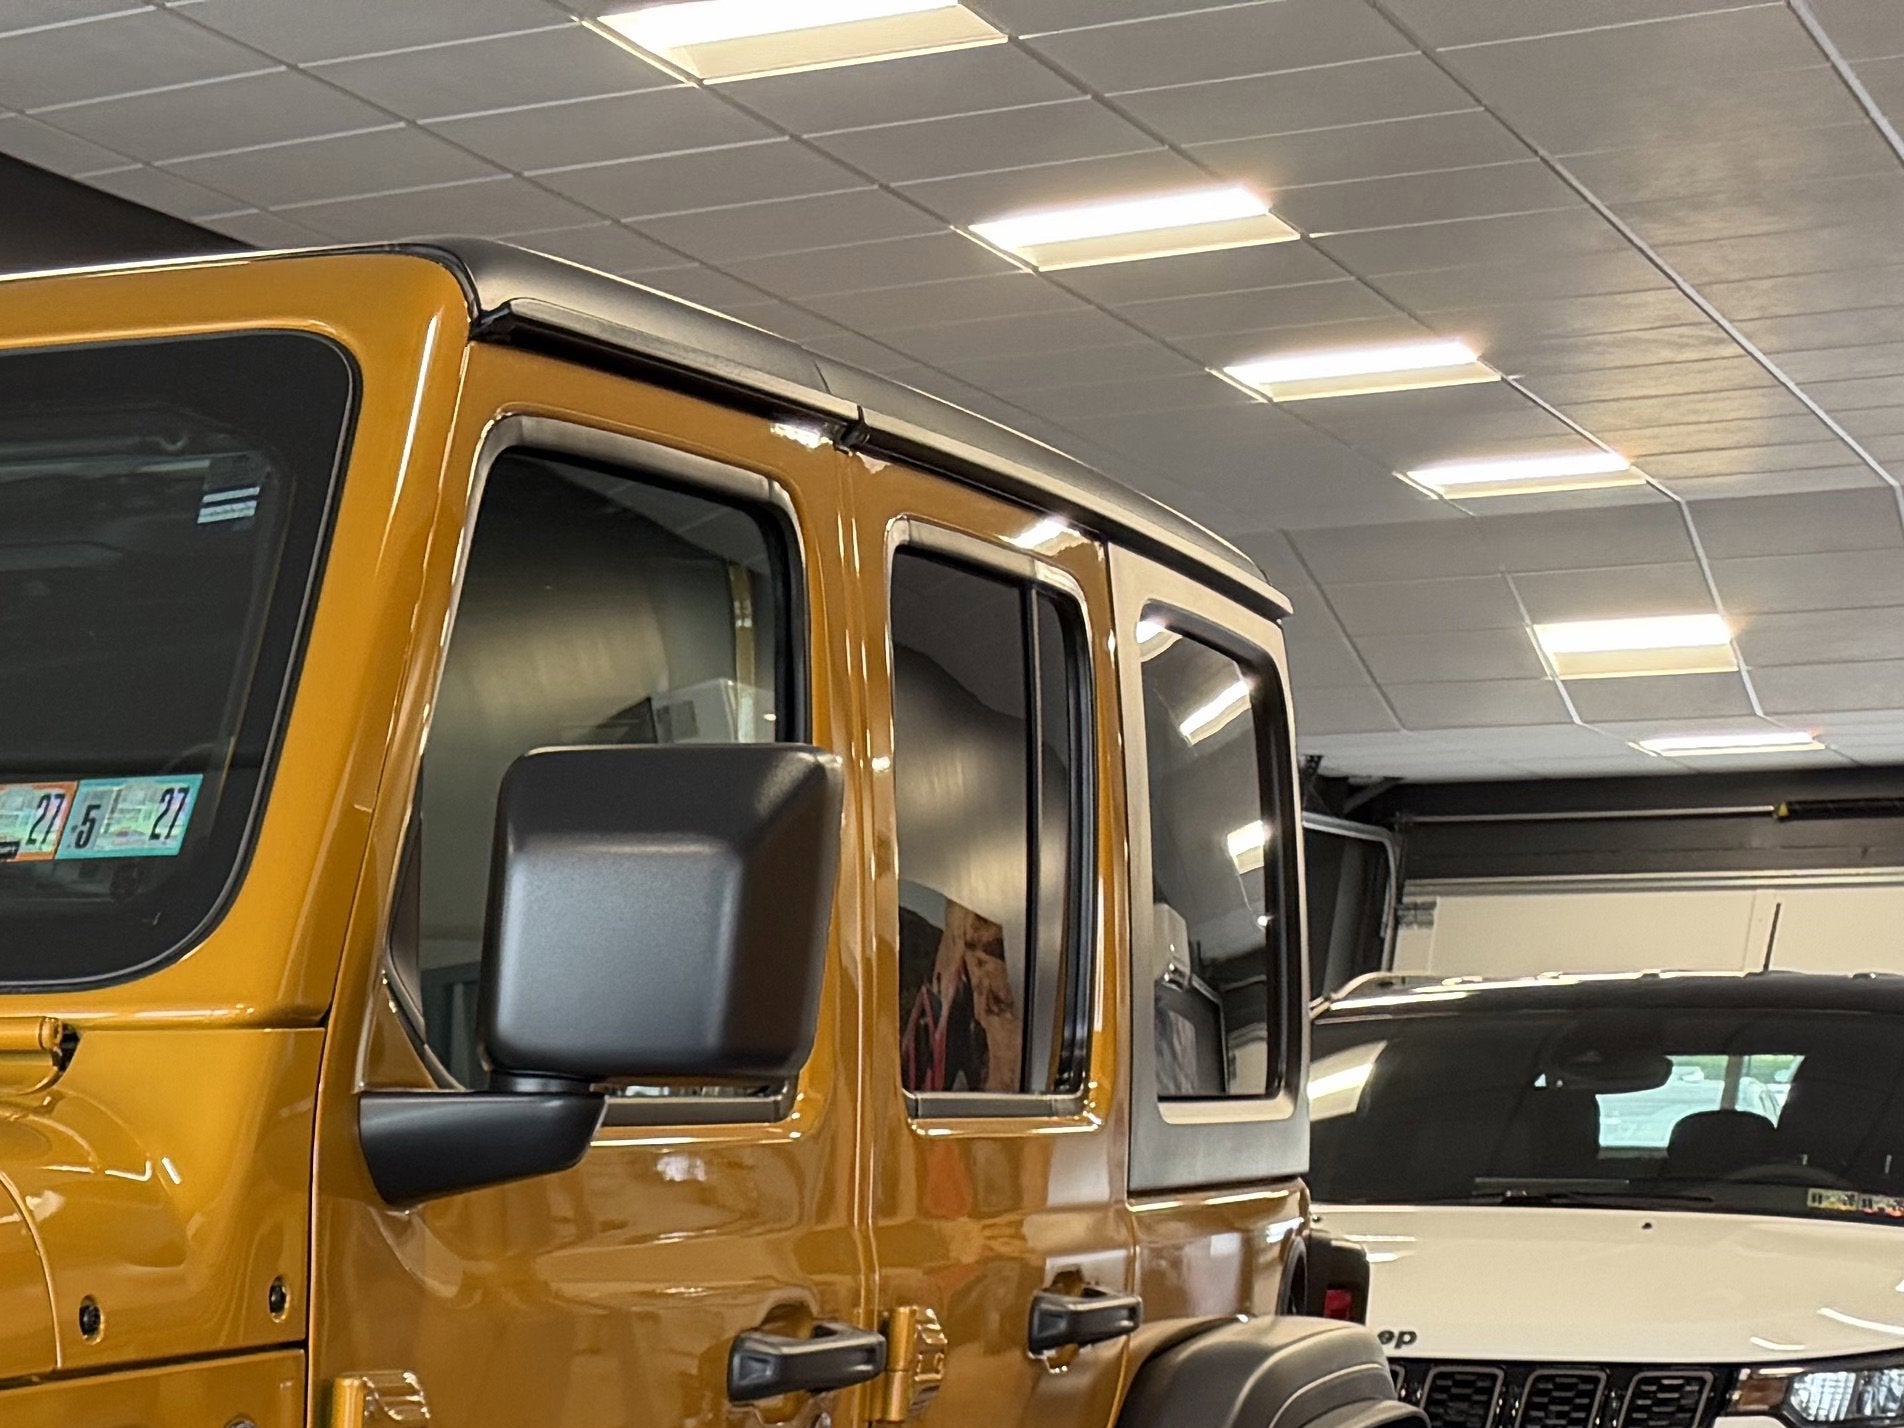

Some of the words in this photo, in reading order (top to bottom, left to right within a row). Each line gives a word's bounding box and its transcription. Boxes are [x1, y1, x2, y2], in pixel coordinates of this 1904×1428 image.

[25, 793, 66, 848] 27
[74, 803, 103, 850] 5
[148, 786, 190, 842] 27
[1378, 1329, 1418, 1349] ep
